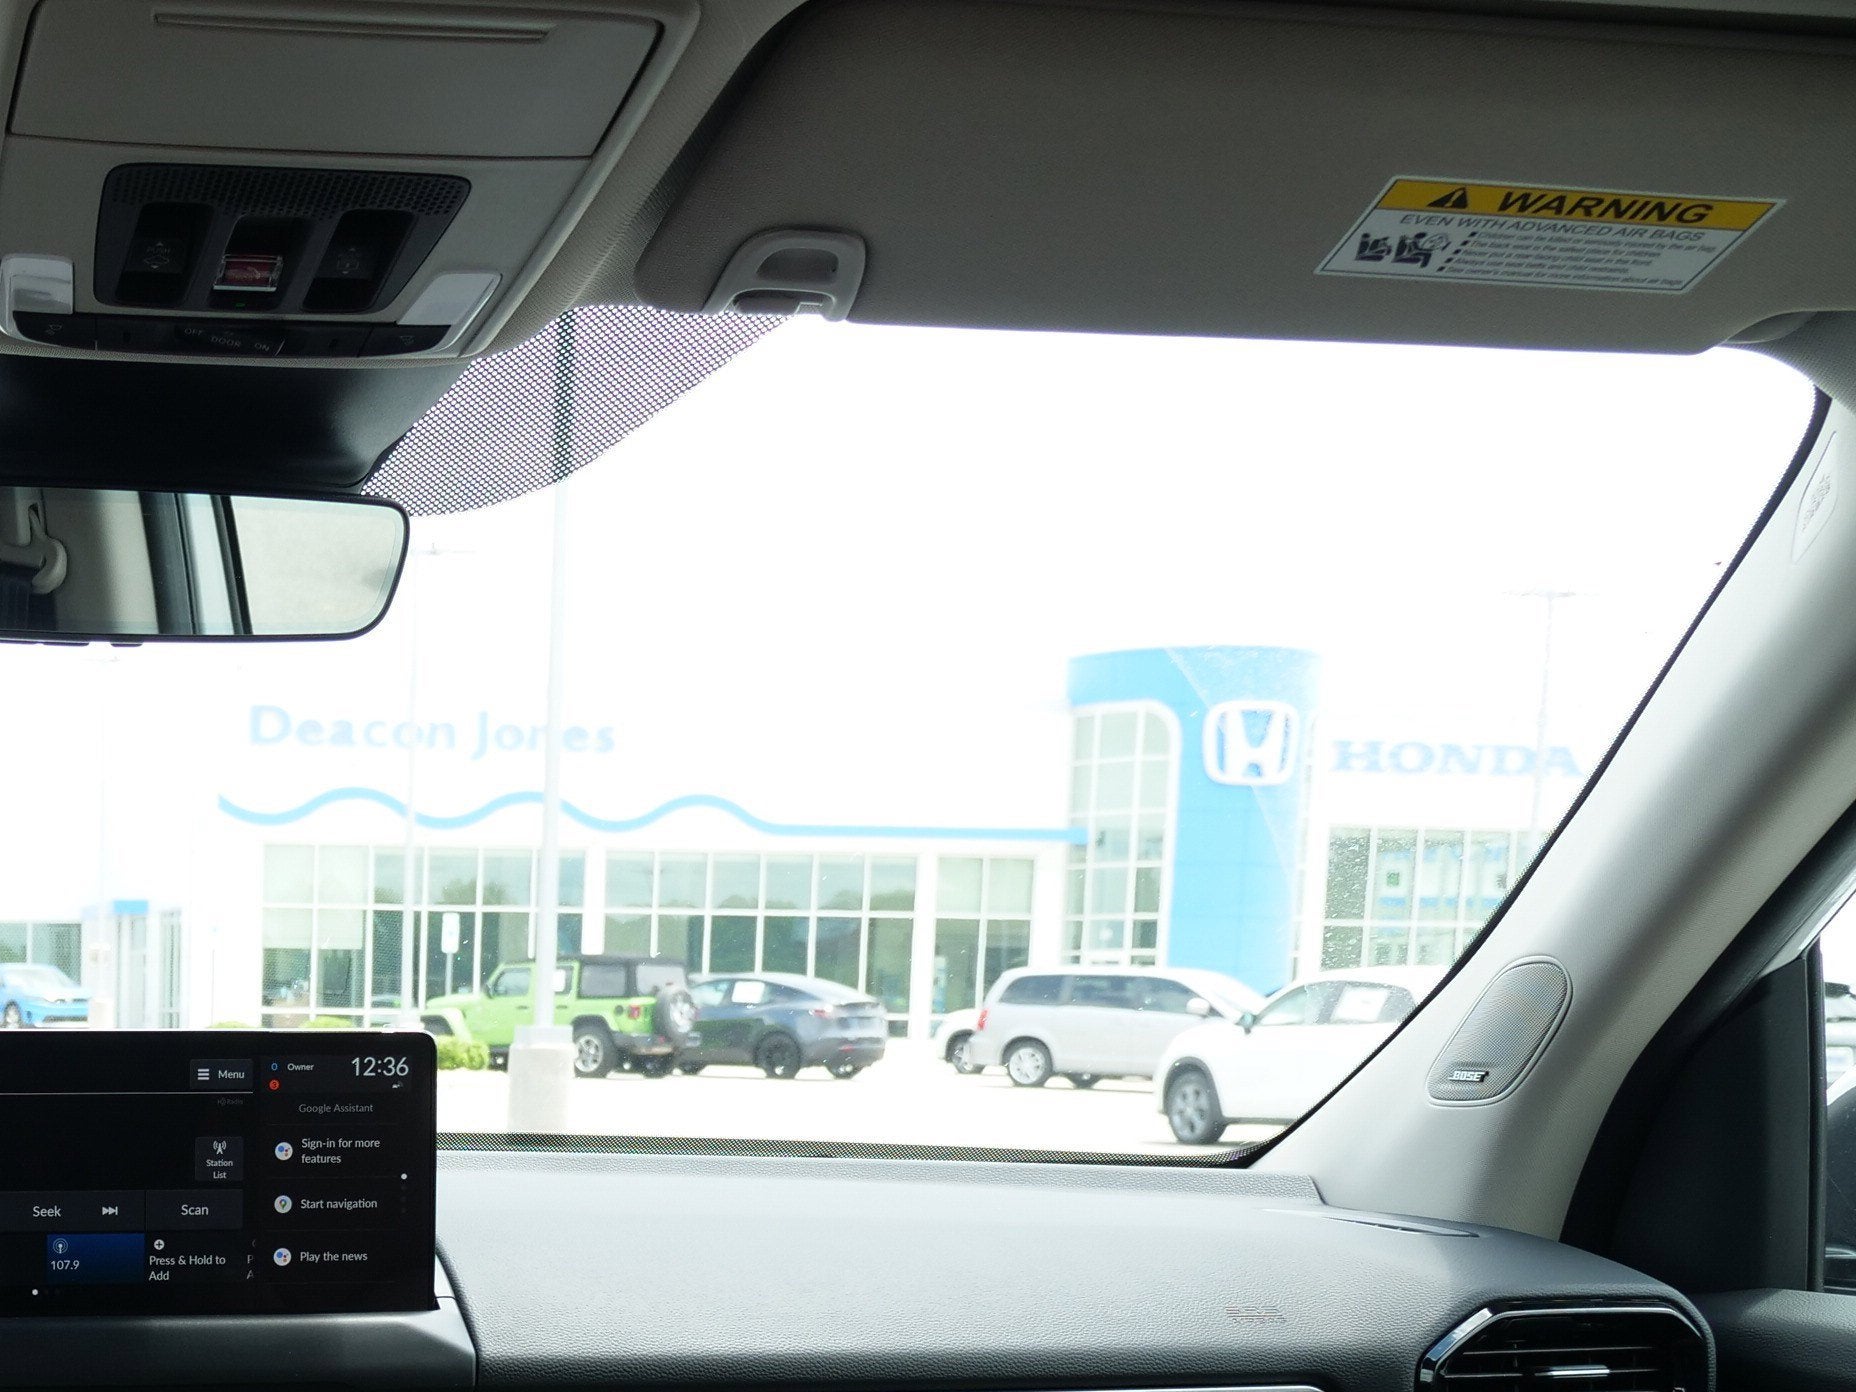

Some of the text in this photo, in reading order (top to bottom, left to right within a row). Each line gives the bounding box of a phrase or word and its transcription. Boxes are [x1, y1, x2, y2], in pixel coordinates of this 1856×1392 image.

[1497, 191, 1714, 224] WARNING
[1399, 214, 1706, 241] EVEN WITH ADVANCED AIR BAGS
[248, 704, 457, 750] Deacon
[1330, 739, 1584, 778] HONDA
[351, 1057, 409, 1076] 12:36
[218, 1070, 245, 1079] Menu
[1448, 1070, 1489, 1082] BOSE
[299, 1103, 374, 1114] Google Assistant
[301, 1138, 380, 1150] Sign-in for more
[206, 1159, 233, 1167] Station
[301, 1154, 341, 1164] features
[213, 1171, 226, 1179] List
[300, 1199, 378, 1210] Start navigation
[33, 1206, 61, 1217] Seek
[181, 1205, 209, 1216] Scan
[149, 1255, 226, 1265] Press & Hold to
[300, 1252, 368, 1263] Play the news
[50, 1261, 80, 1270] 107.9
[148, 1271, 170, 1281] Add
